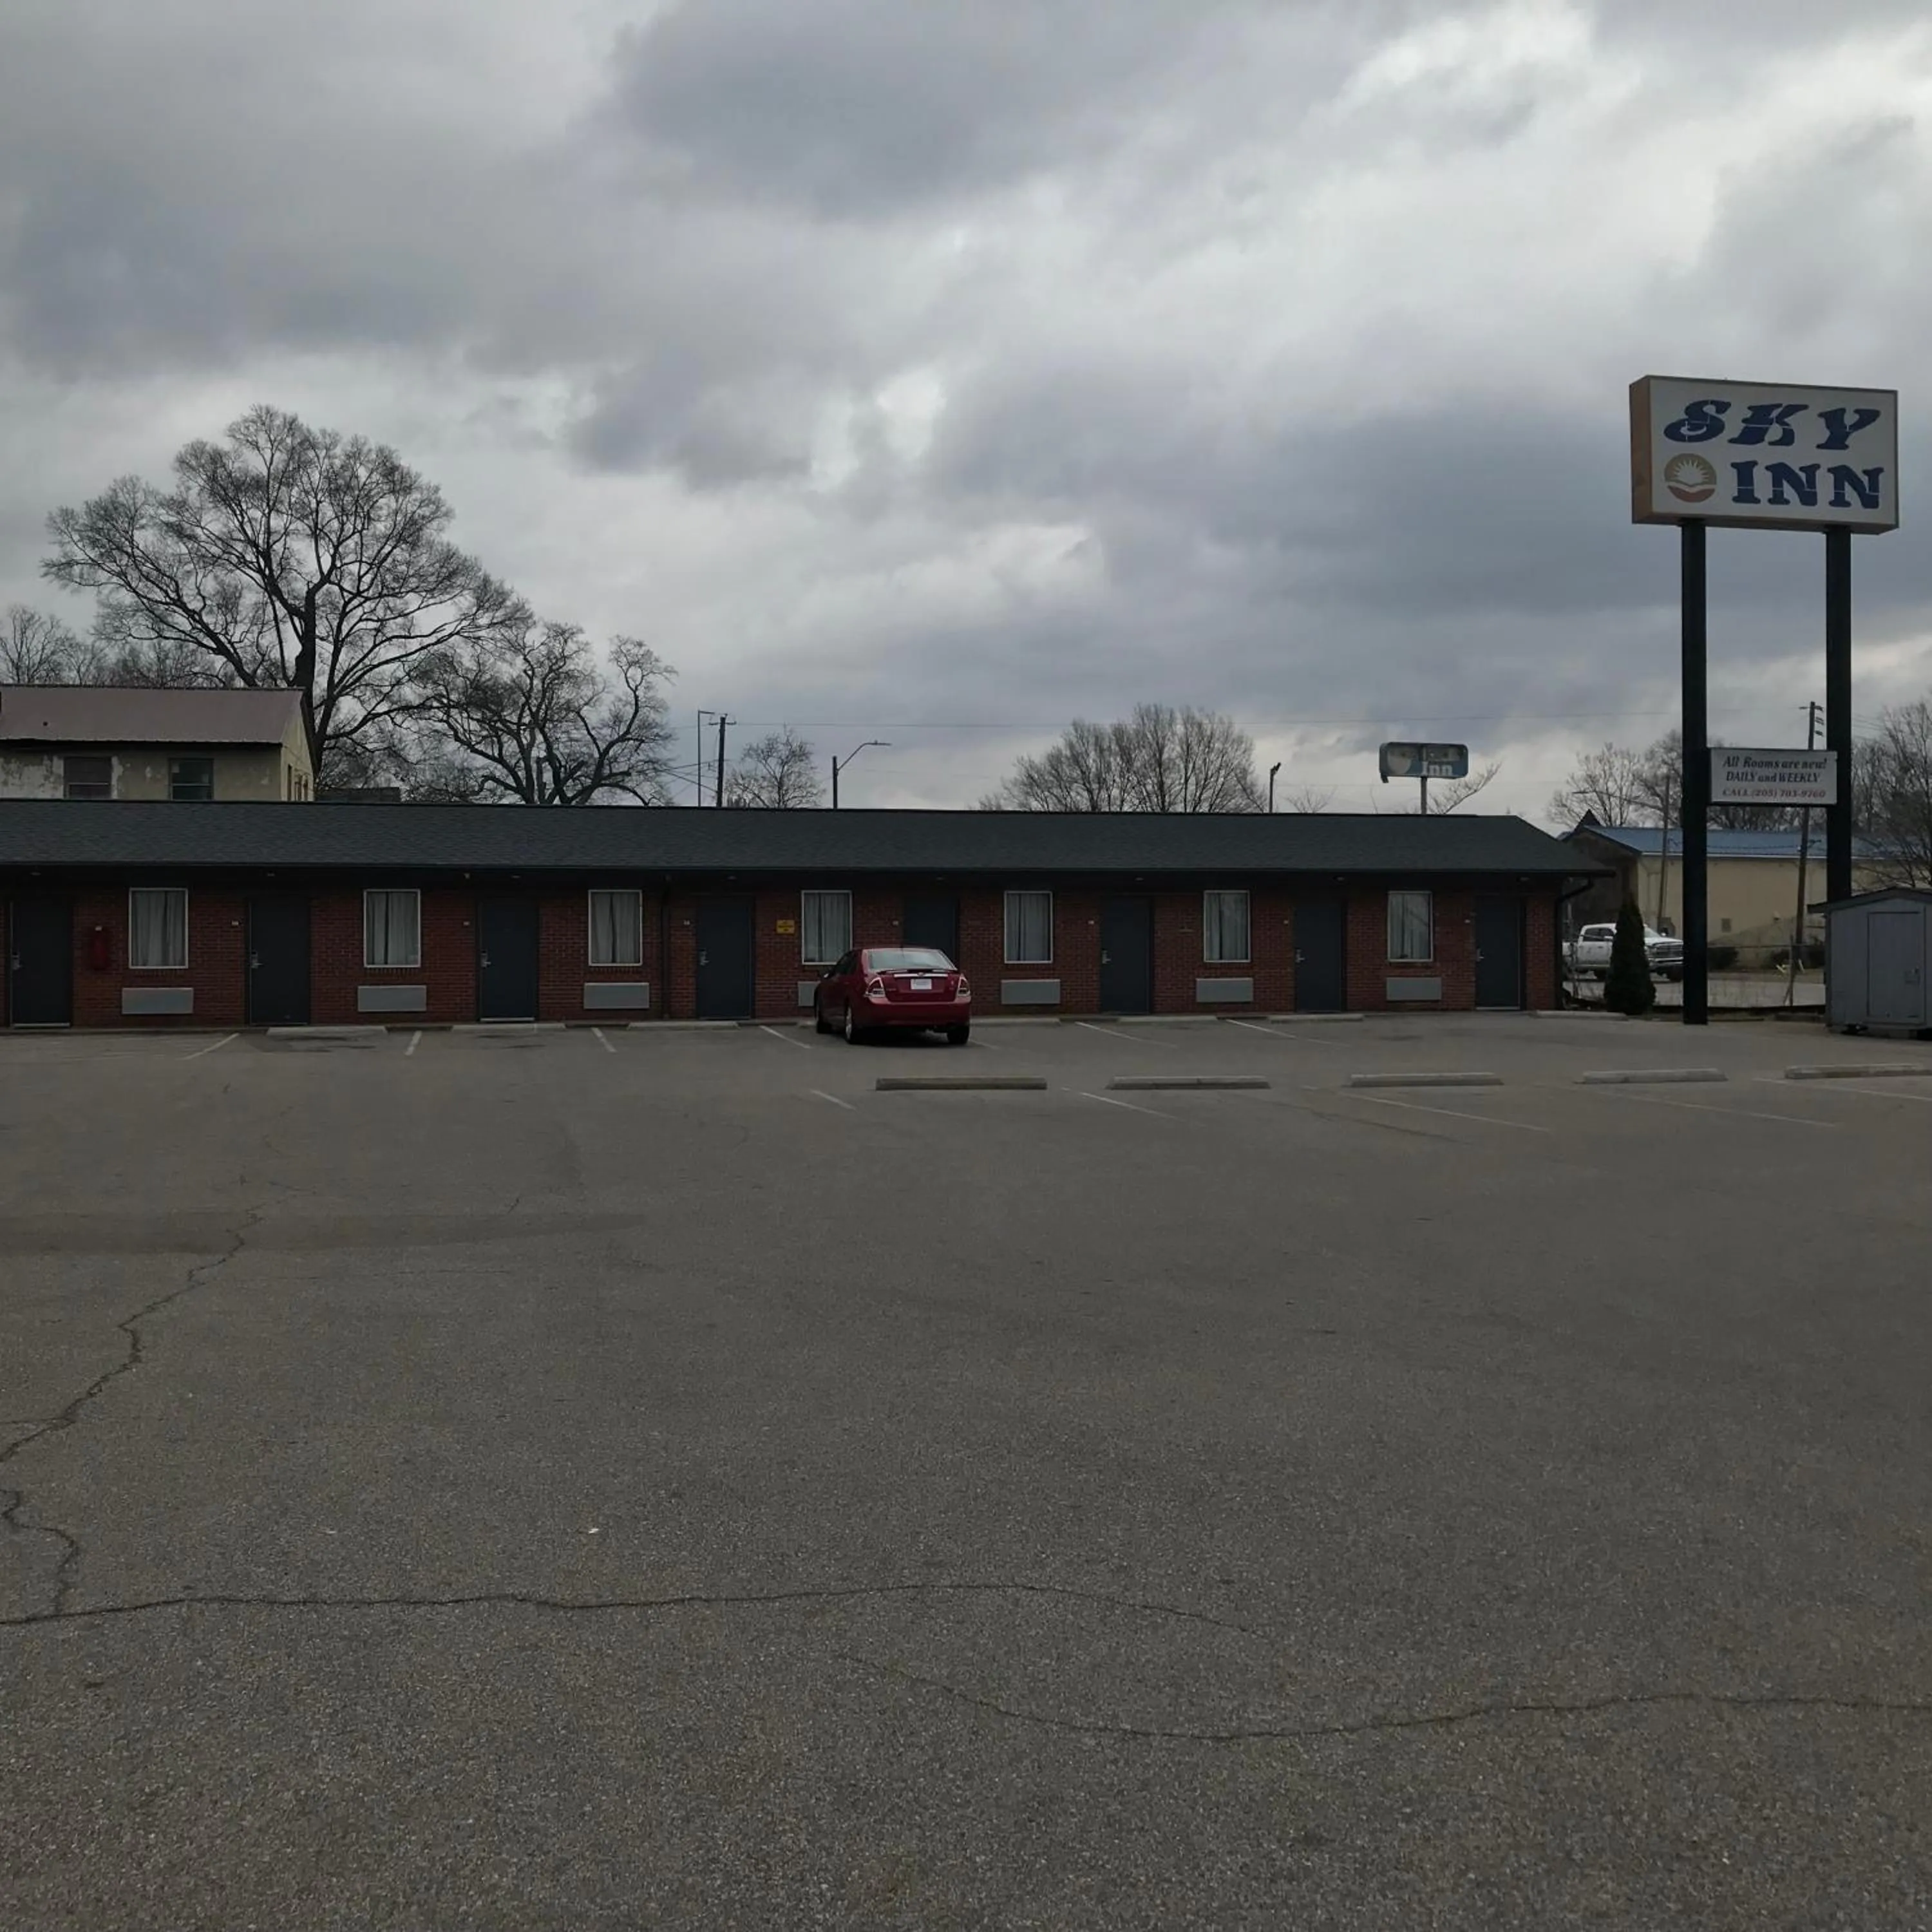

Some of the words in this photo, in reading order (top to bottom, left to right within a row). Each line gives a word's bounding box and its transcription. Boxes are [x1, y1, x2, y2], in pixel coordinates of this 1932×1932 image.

[1663, 399, 1880, 450] SKY
[1730, 460, 1884, 509] INN
[1421, 761, 1453, 776] Inn
[1723, 756, 1739, 768] All
[1743, 757, 1780, 768] Rooms
[1781, 760, 1801, 768] are
[1802, 757, 1828, 769] new!
[1726, 772, 1756, 782] DAILY
[1757, 773, 1777, 782] and
[1779, 772, 1821, 783] WEEKLY
[1723, 788, 1750, 797] CALL
